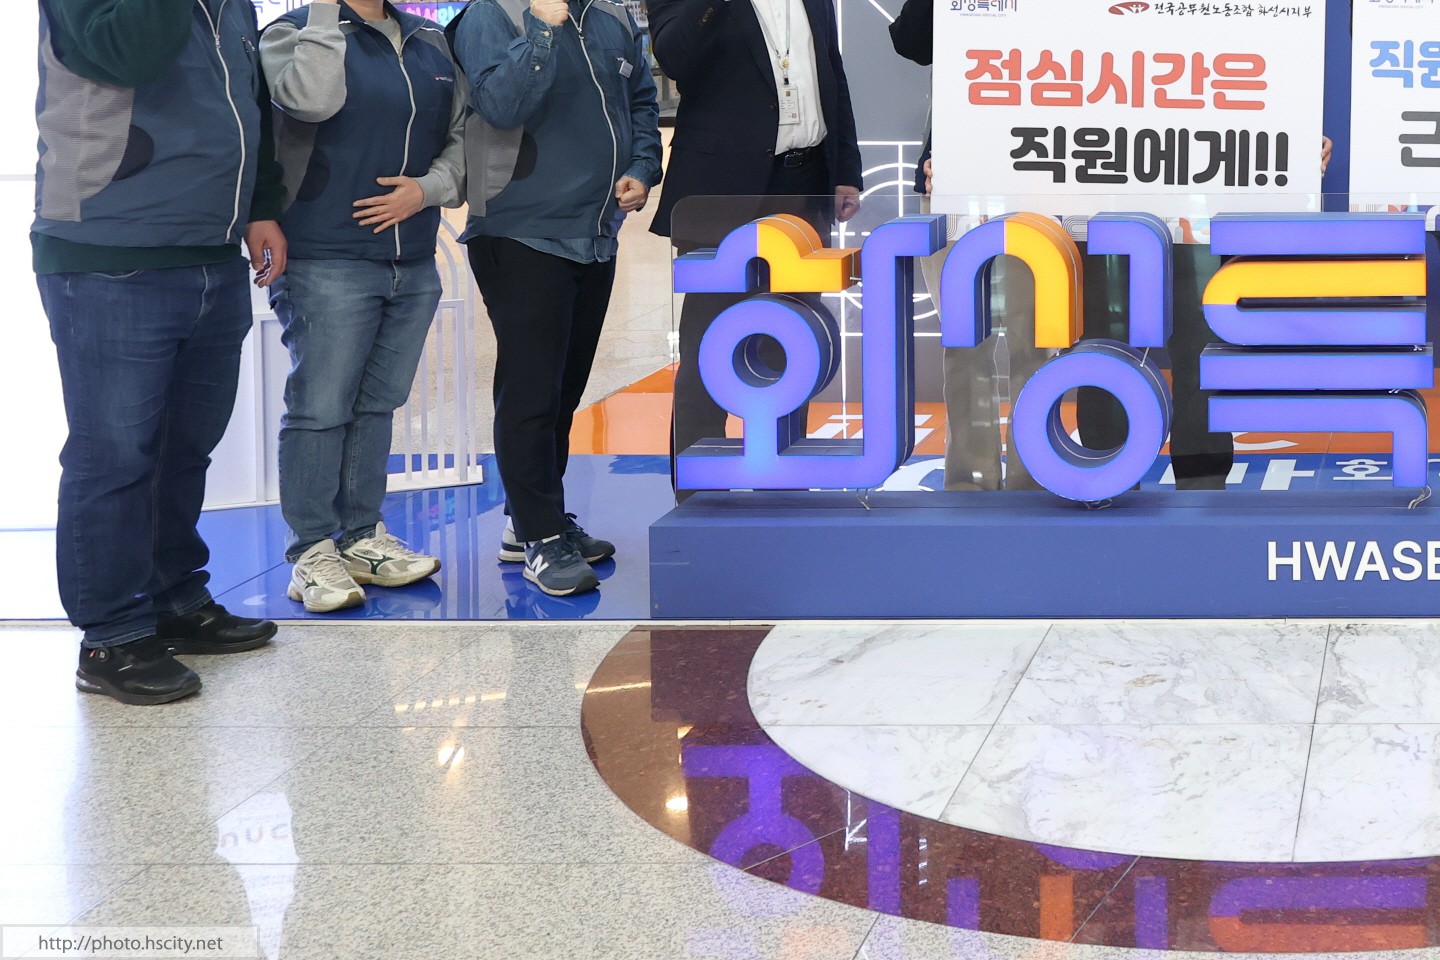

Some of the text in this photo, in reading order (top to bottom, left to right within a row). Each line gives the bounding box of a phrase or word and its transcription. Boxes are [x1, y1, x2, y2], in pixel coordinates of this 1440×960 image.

[1154, 2, 1313, 18] 전국공무원노동조합 화성시지부
[964, 48, 1268, 111] 점심시간은
[1009, 125, 1289, 187] 직원에게!!
